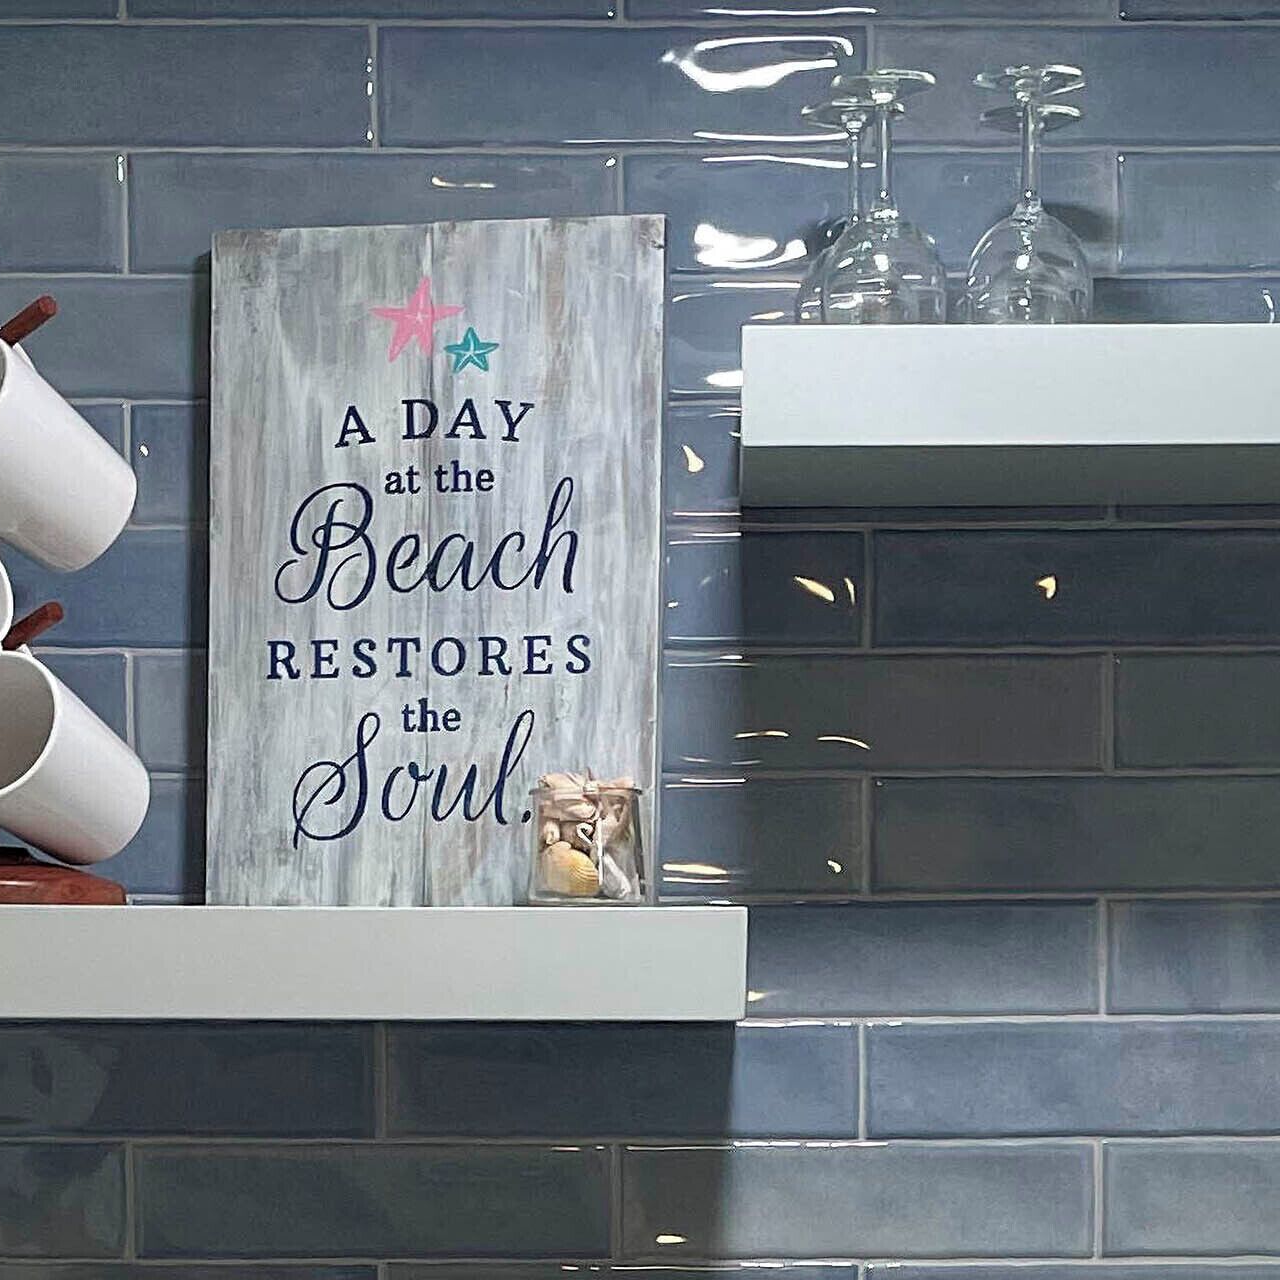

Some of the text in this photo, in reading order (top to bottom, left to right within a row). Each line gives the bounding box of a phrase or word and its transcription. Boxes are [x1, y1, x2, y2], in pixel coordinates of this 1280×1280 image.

[334, 398, 535, 448] A DAY
[384, 459, 495, 495] at the
[275, 476, 578, 611] Beach
[266, 634, 591, 680] RESTORES
[401, 697, 462, 733] the
[292, 709, 535, 851] Soul.
